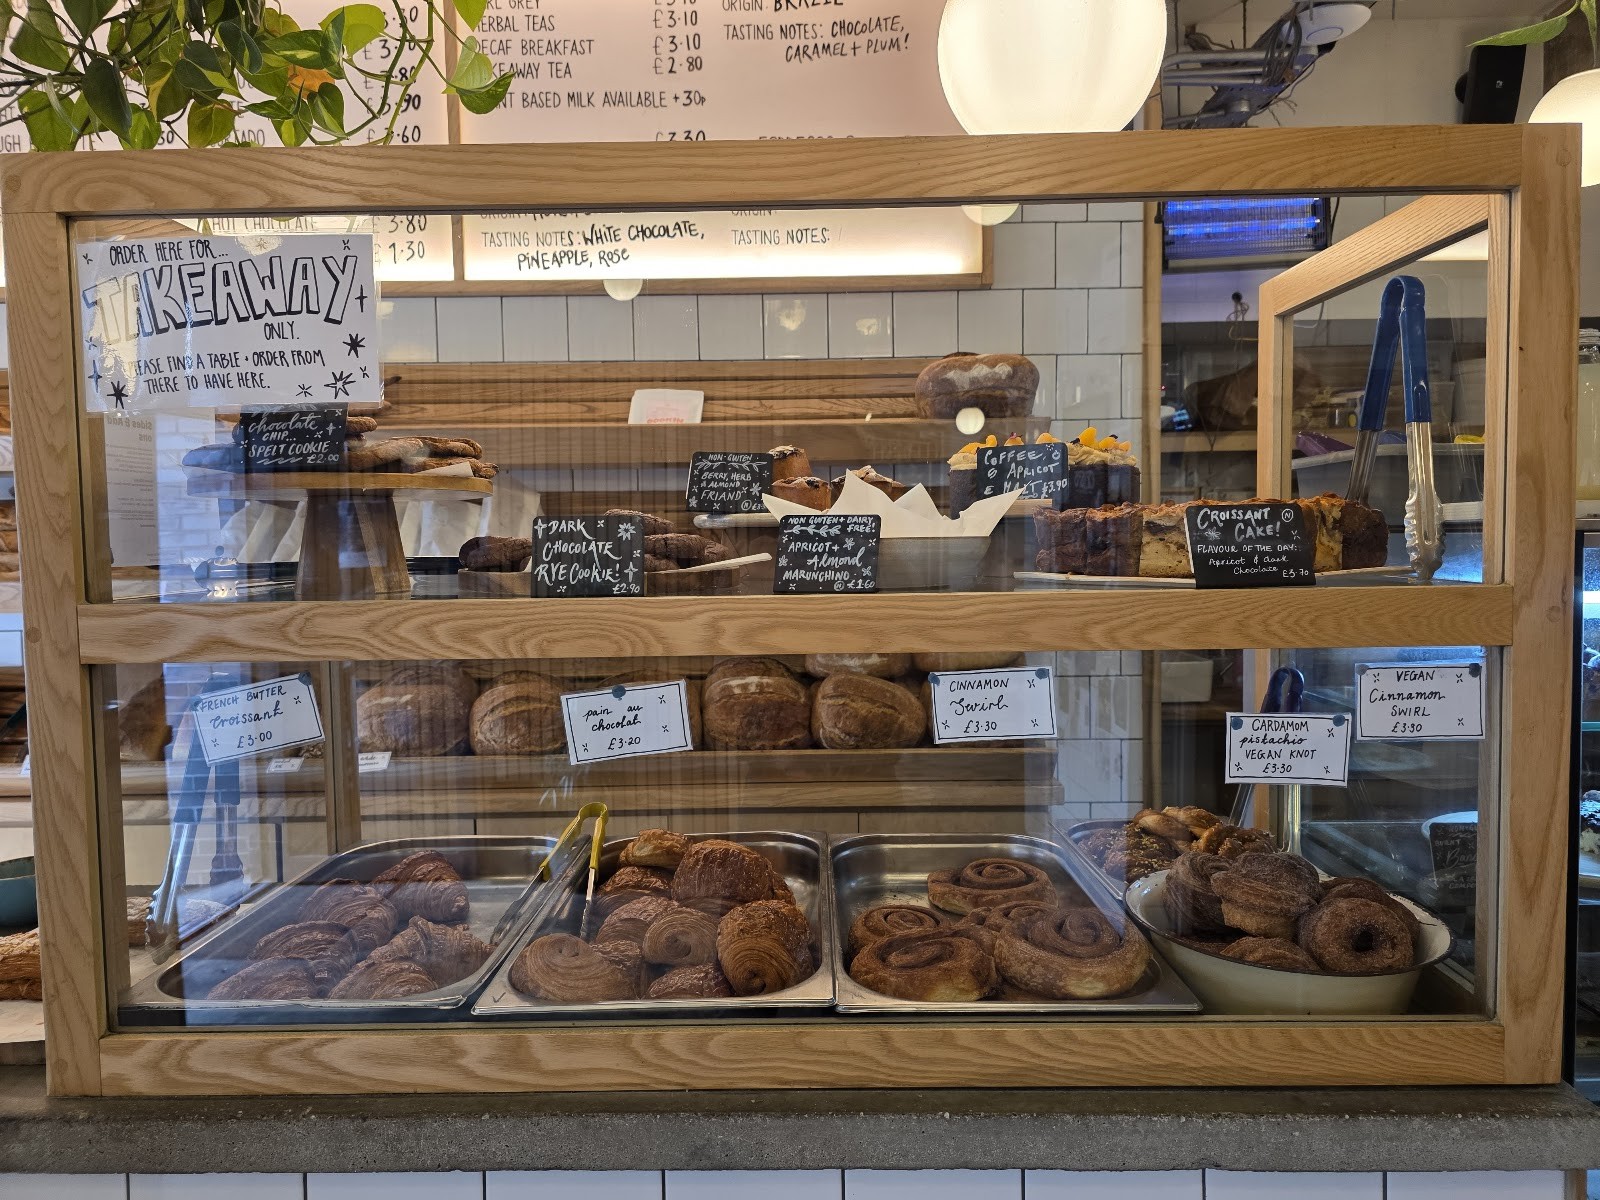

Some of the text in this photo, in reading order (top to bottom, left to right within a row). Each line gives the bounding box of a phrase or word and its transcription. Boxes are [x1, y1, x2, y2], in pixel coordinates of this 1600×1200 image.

[477, 15, 520, 32] ERBAL
[525, 14, 555, 32] TEAS
[723, 15, 904, 41] TASTING NOTES: CHOCOLATE,
[521, 38, 595, 56] BREAKFAST
[785, 33, 910, 63] CARAMEL + PLUM!
[547, 61, 572, 79] TEA
[521, 91, 561, 108] BASED
[567, 91, 595, 108] MILK
[602, 91, 667, 108] AVAILABLE
[481, 231, 530, 248] TASTING
[536, 230, 581, 248] NOTES:
[628, 220, 704, 240] CHOCOLATE,
[731, 227, 830, 245] TASTING NOTES:
[110, 244, 148, 266] ORDER
[155, 241, 184, 262] HERE
[82, 255, 358, 345] TAKEAWAY
[264, 322, 300, 341] ONLY.
[196, 353, 206, 369] A
[207, 352, 241, 369] TABLE
[252, 350, 290, 368] ORDER
[292, 349, 326, 368] FROM
[143, 371, 270, 394] THERE TO HAVE HERE.
[249, 441, 331, 458] SPELT COOKIE
[701, 471, 752, 481] BERRY, HERB
[1007, 462, 1059, 479] APRICOT
[701, 490, 742, 501] FRIAND
[788, 516, 806, 524] NON
[846, 516, 874, 525] DAIRY
[1197, 507, 1271, 530] CROISSANT
[548, 519, 596, 540] DARK
[847, 523, 875, 533] FREE!
[1235, 521, 1280, 542] CAKE!
[542, 540, 622, 562] CHOCOLATE
[788, 541, 832, 552] APRICOT
[1197, 544, 1238, 554] FLAVOUR
[1242, 544, 1253, 552] OF
[1254, 544, 1272, 552] THE
[806, 546, 866, 570] Almond
[534, 562, 621, 586] RYE COOKIE!
[949, 678, 1010, 692] CINNAMON
[1396, 670, 1435, 682] VEGAN
[200, 685, 287, 712] FRENCH BUTTER
[1369, 688, 1446, 703] Cinnamon
[582, 705, 643, 722] pain au
[1391, 704, 1431, 717] SWIRL
[591, 713, 642, 732] chocolat
[1251, 718, 1309, 732] CARDAMOM
[1239, 733, 1307, 748] pistachio
[1245, 749, 1317, 760] VEGAN KNOT
